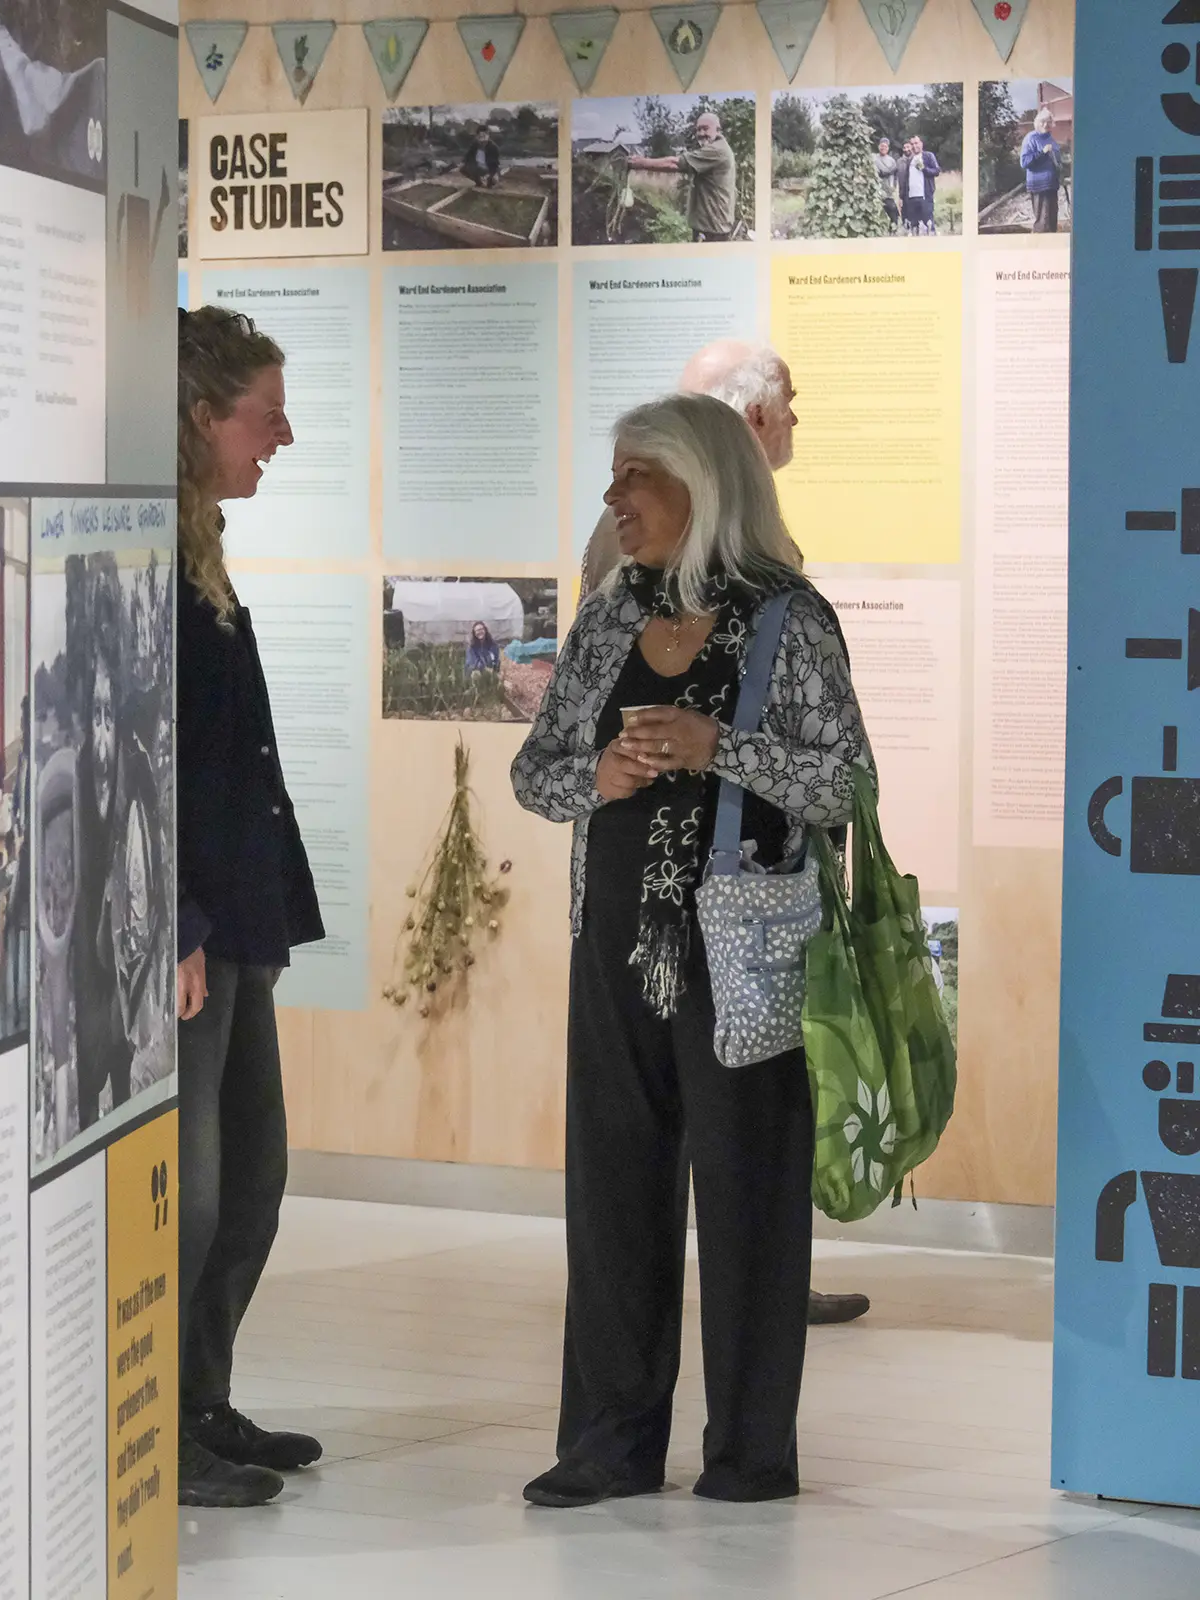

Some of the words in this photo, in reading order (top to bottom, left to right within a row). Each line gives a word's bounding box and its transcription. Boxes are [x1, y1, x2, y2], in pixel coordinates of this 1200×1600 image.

[210, 132, 287, 181] CASE
[210, 181, 344, 232] STUDIES
[788, 275, 808, 285] Ward
[809, 275, 822, 285] End
[823, 274, 862, 285] Gardeners
[863, 274, 905, 284] Association
[996, 271, 1016, 281] Ward
[1017, 271, 1031, 281] End
[398, 285, 417, 295] Ward
[418, 285, 430, 295] End
[467, 283, 507, 294] Association
[589, 280, 608, 290] Ward
[609, 280, 622, 289] End
[622, 279, 660, 289] Gardeners
[661, 278, 702, 288] Association
[861, 600, 904, 610] Association
